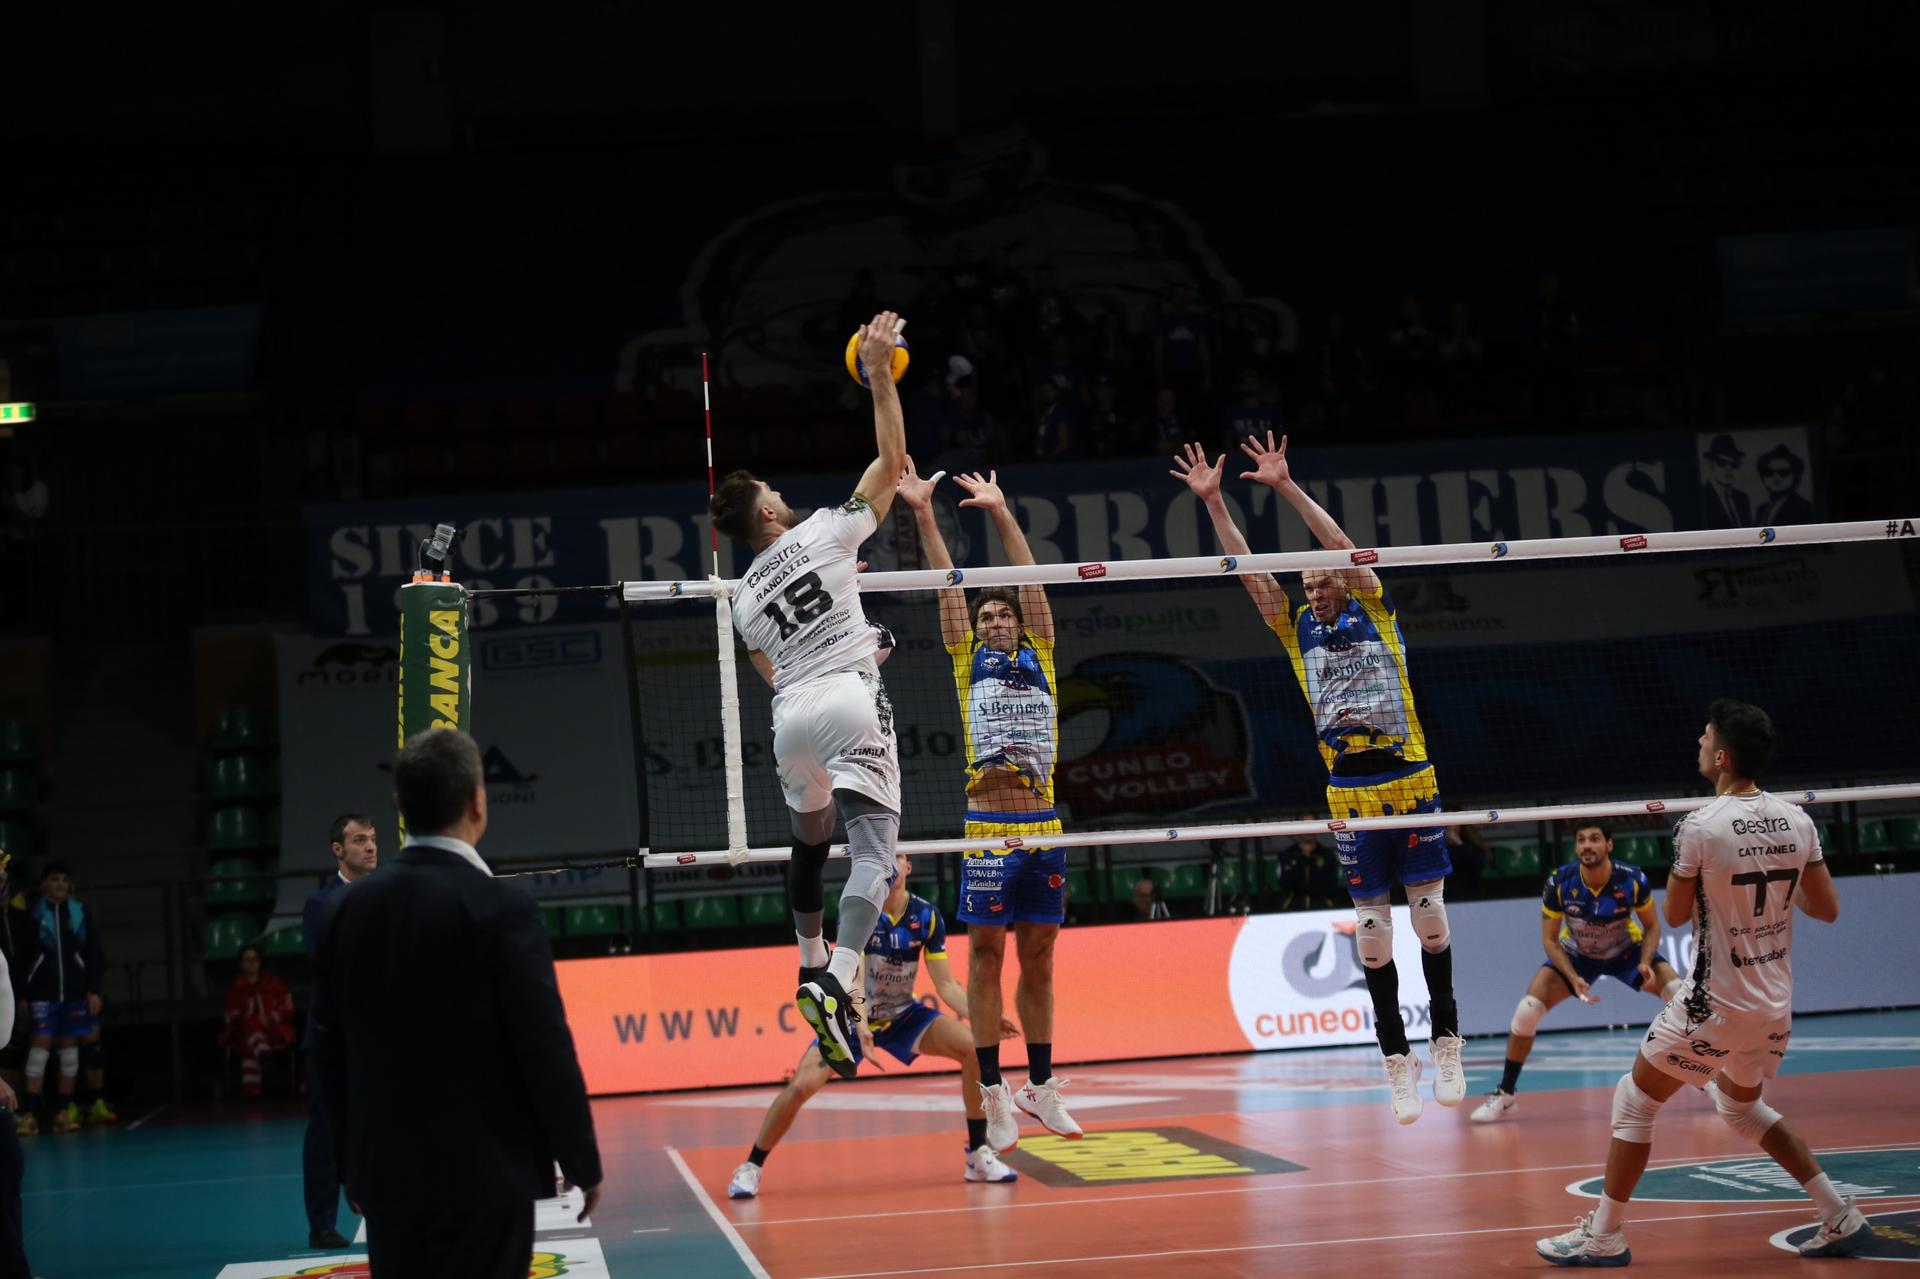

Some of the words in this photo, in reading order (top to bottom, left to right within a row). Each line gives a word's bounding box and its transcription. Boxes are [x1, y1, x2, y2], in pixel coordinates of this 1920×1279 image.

[980, 461, 1675, 568] BROTHERS
[756, 555, 811, 602] RANDAZZO
[763, 571, 834, 642] 18
[1067, 751, 1191, 783] CUNEO
[1093, 767, 1230, 801] VOLLEY
[1739, 843, 1797, 857] CATTANEO
[1731, 868, 1799, 917] 77
[1255, 1004, 1431, 1038] cuneoiox
